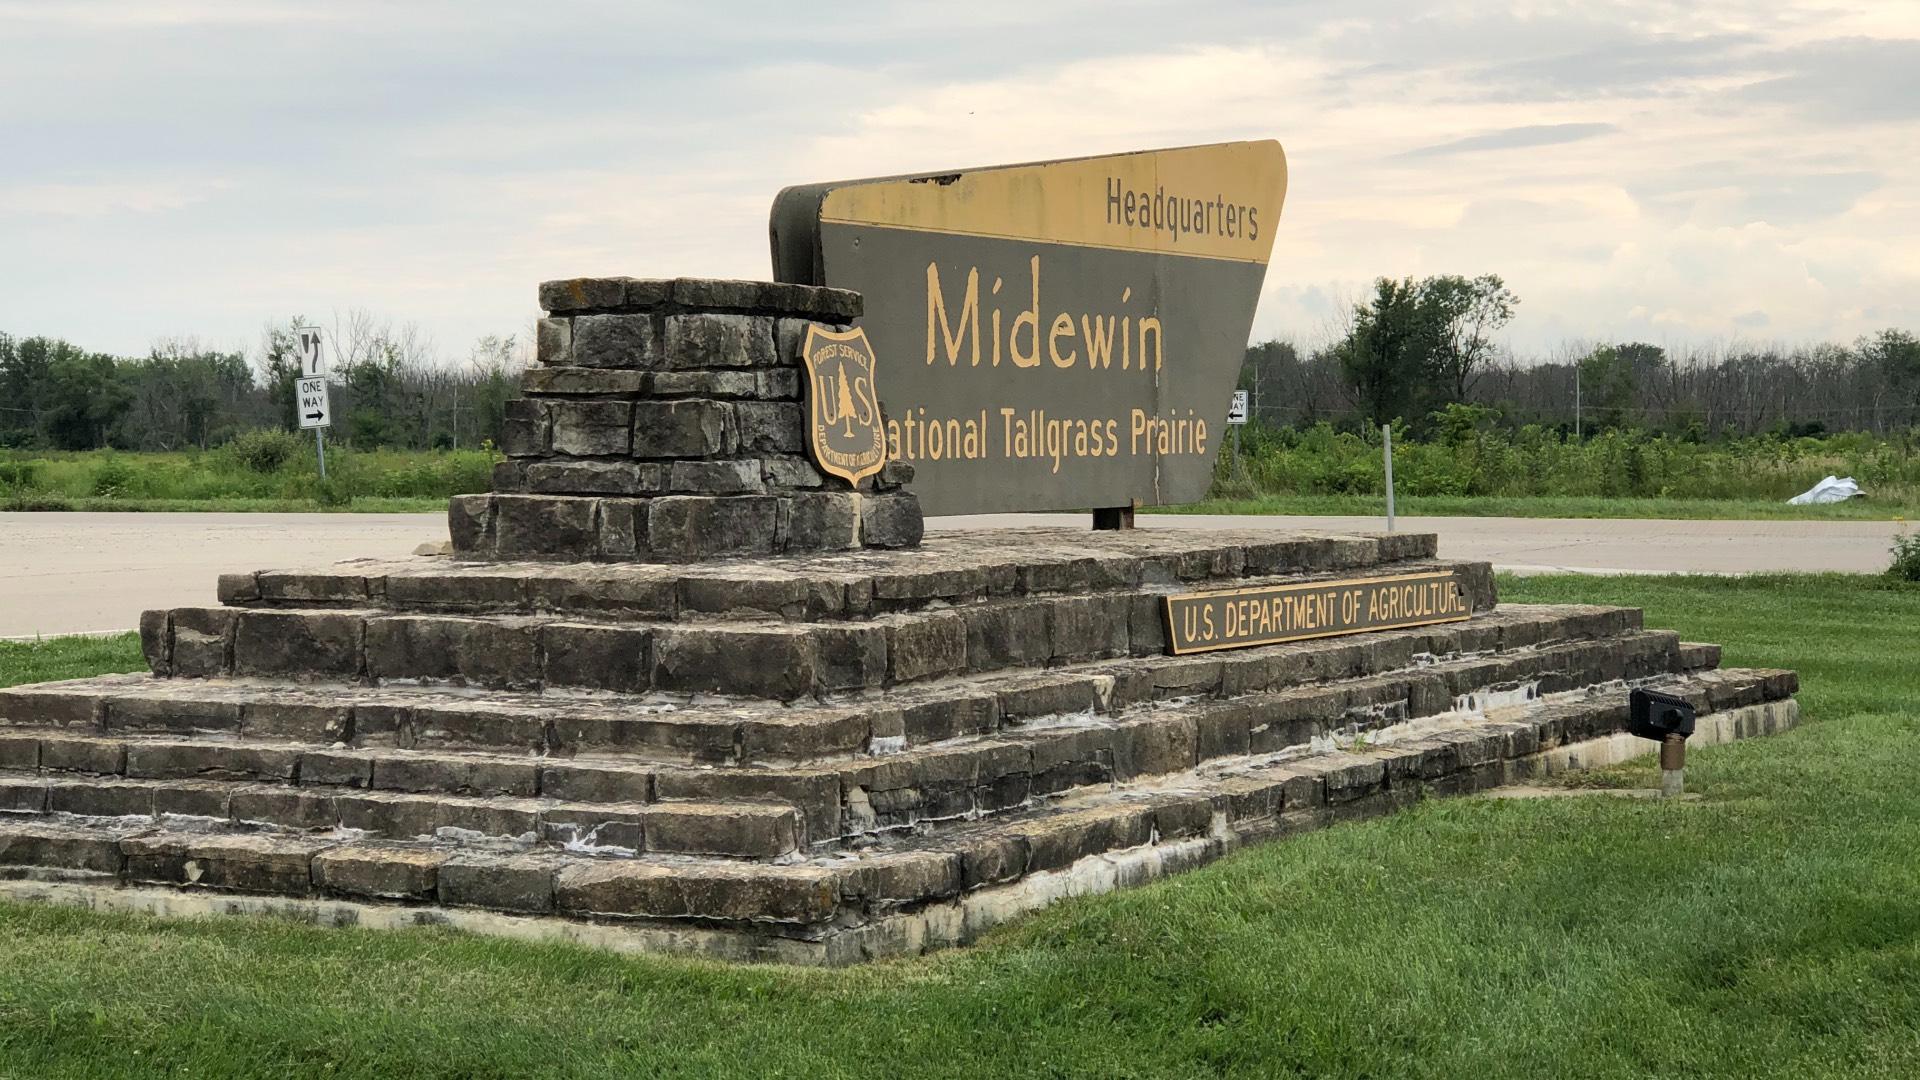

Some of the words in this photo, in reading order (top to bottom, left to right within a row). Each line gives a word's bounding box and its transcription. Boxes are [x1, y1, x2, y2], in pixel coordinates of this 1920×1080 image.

[1107, 177, 1258, 242] Headquarters
[926, 254, 1162, 370] Midewin
[813, 344, 837, 370] FOREST
[839, 344, 869, 371] SERVICE
[303, 380, 322, 393] ONE
[303, 396, 323, 408] WAY
[818, 375, 837, 426] U
[854, 376, 873, 426] S
[888, 408, 987, 460] ational
[1001, 408, 1118, 474] Tallgrass
[1131, 408, 1207, 456] Prairie
[1184, 603, 1219, 643] U.S.
[1226, 591, 1337, 638] DEPARTMENT
[1343, 589, 1363, 625] OF
